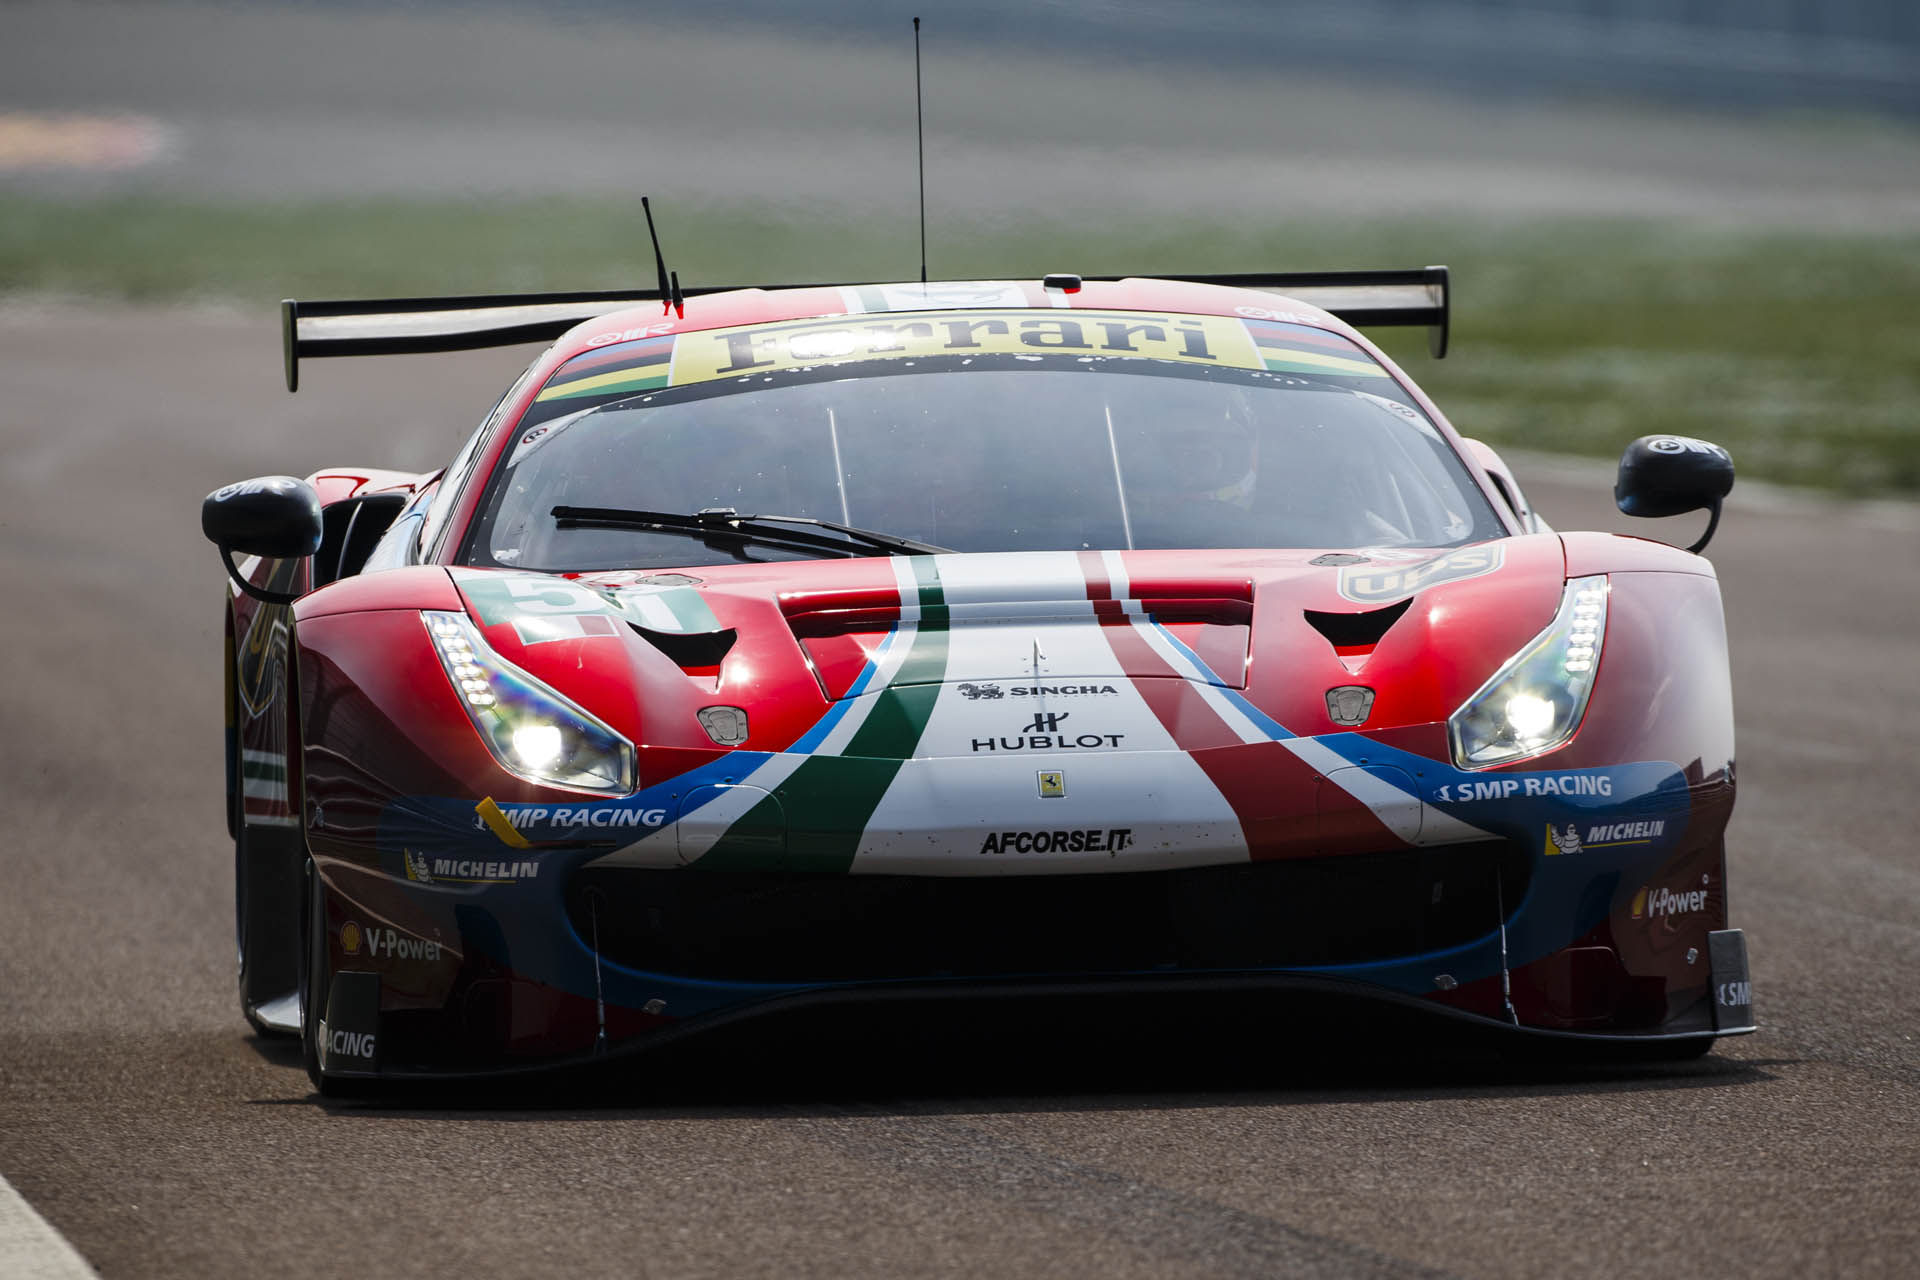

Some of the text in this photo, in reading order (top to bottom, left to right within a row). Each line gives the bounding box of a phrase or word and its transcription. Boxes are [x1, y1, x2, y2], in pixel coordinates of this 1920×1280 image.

[715, 311, 1217, 374] Frrari
[1010, 685, 1119, 697] SINGHA
[971, 734, 1125, 752] HUBLOT
[1456, 775, 1613, 802] SMP RACING
[550, 808, 667, 828] RACING
[980, 829, 1132, 854] AFCORSE.IT
[1587, 820, 1665, 843] MICHELIN
[434, 858, 540, 878] MICHELIN
[1647, 887, 1708, 918] V-Power
[365, 927, 442, 961] V-Power
